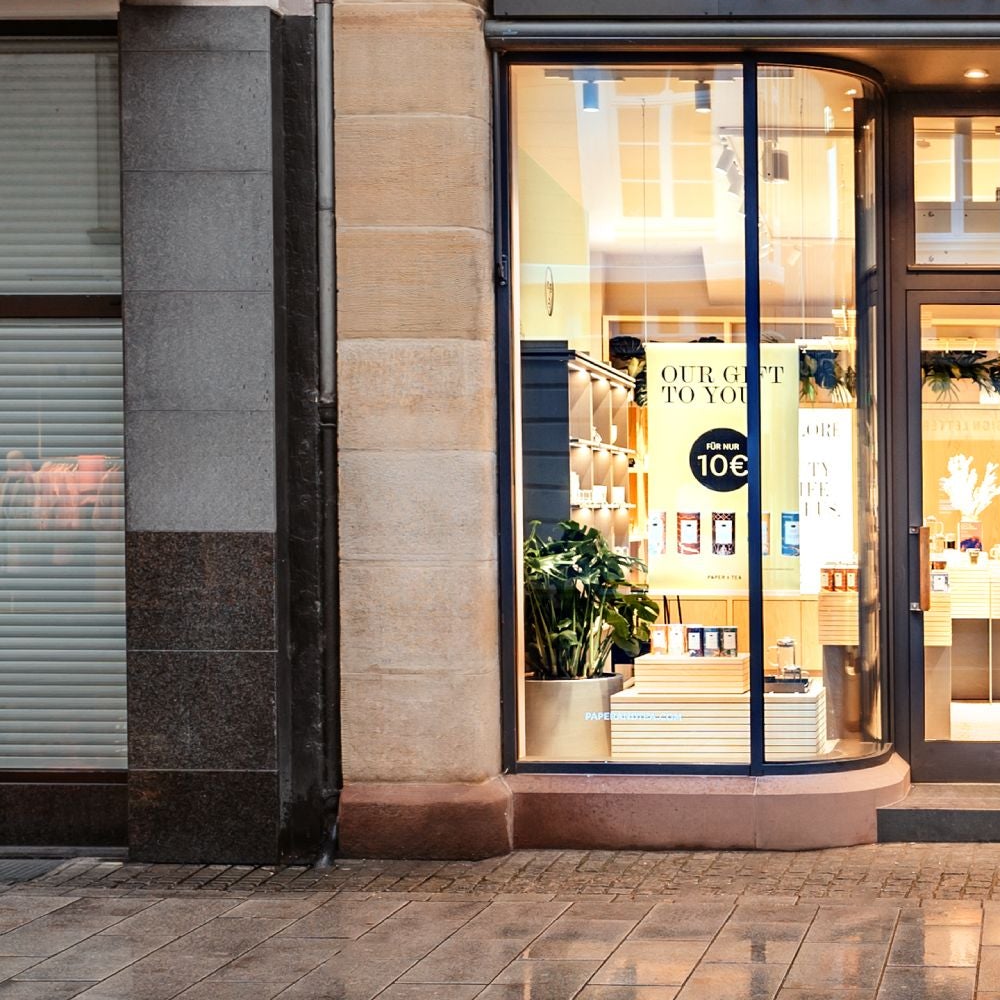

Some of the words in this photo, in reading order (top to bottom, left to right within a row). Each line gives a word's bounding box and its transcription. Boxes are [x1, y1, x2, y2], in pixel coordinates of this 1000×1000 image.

[661, 365, 715, 384] OUR
[661, 386, 695, 404] TO
[706, 441, 721, 451] FÜR
[723, 442, 740, 451] NUR
[697, 454, 749, 477] 10€
